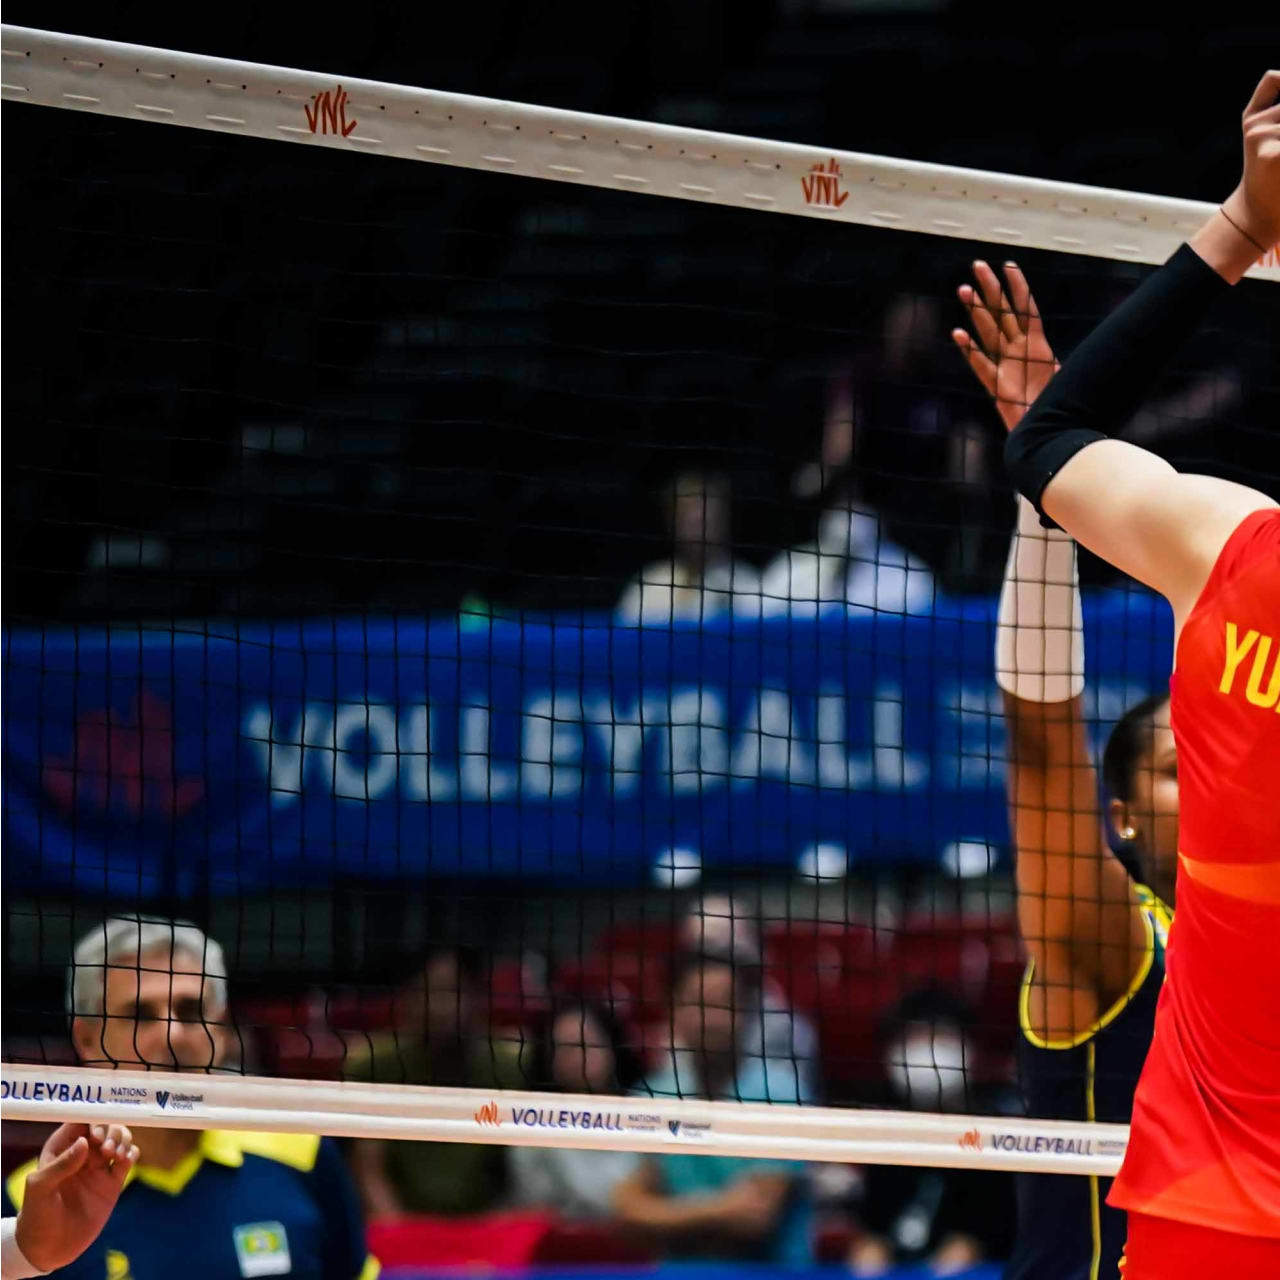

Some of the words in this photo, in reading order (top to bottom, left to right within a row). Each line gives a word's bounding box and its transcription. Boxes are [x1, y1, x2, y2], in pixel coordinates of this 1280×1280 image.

[304, 84, 357, 137] VNL
[801, 157, 850, 207] VNL
[243, 688, 928, 803] VOLLEYBALL
[0, 1080, 106, 1104] OLLEYBALL
[512, 1107, 625, 1132] VOLLEYBALL
[991, 1134, 1094, 1156] VOLLEYBALL
